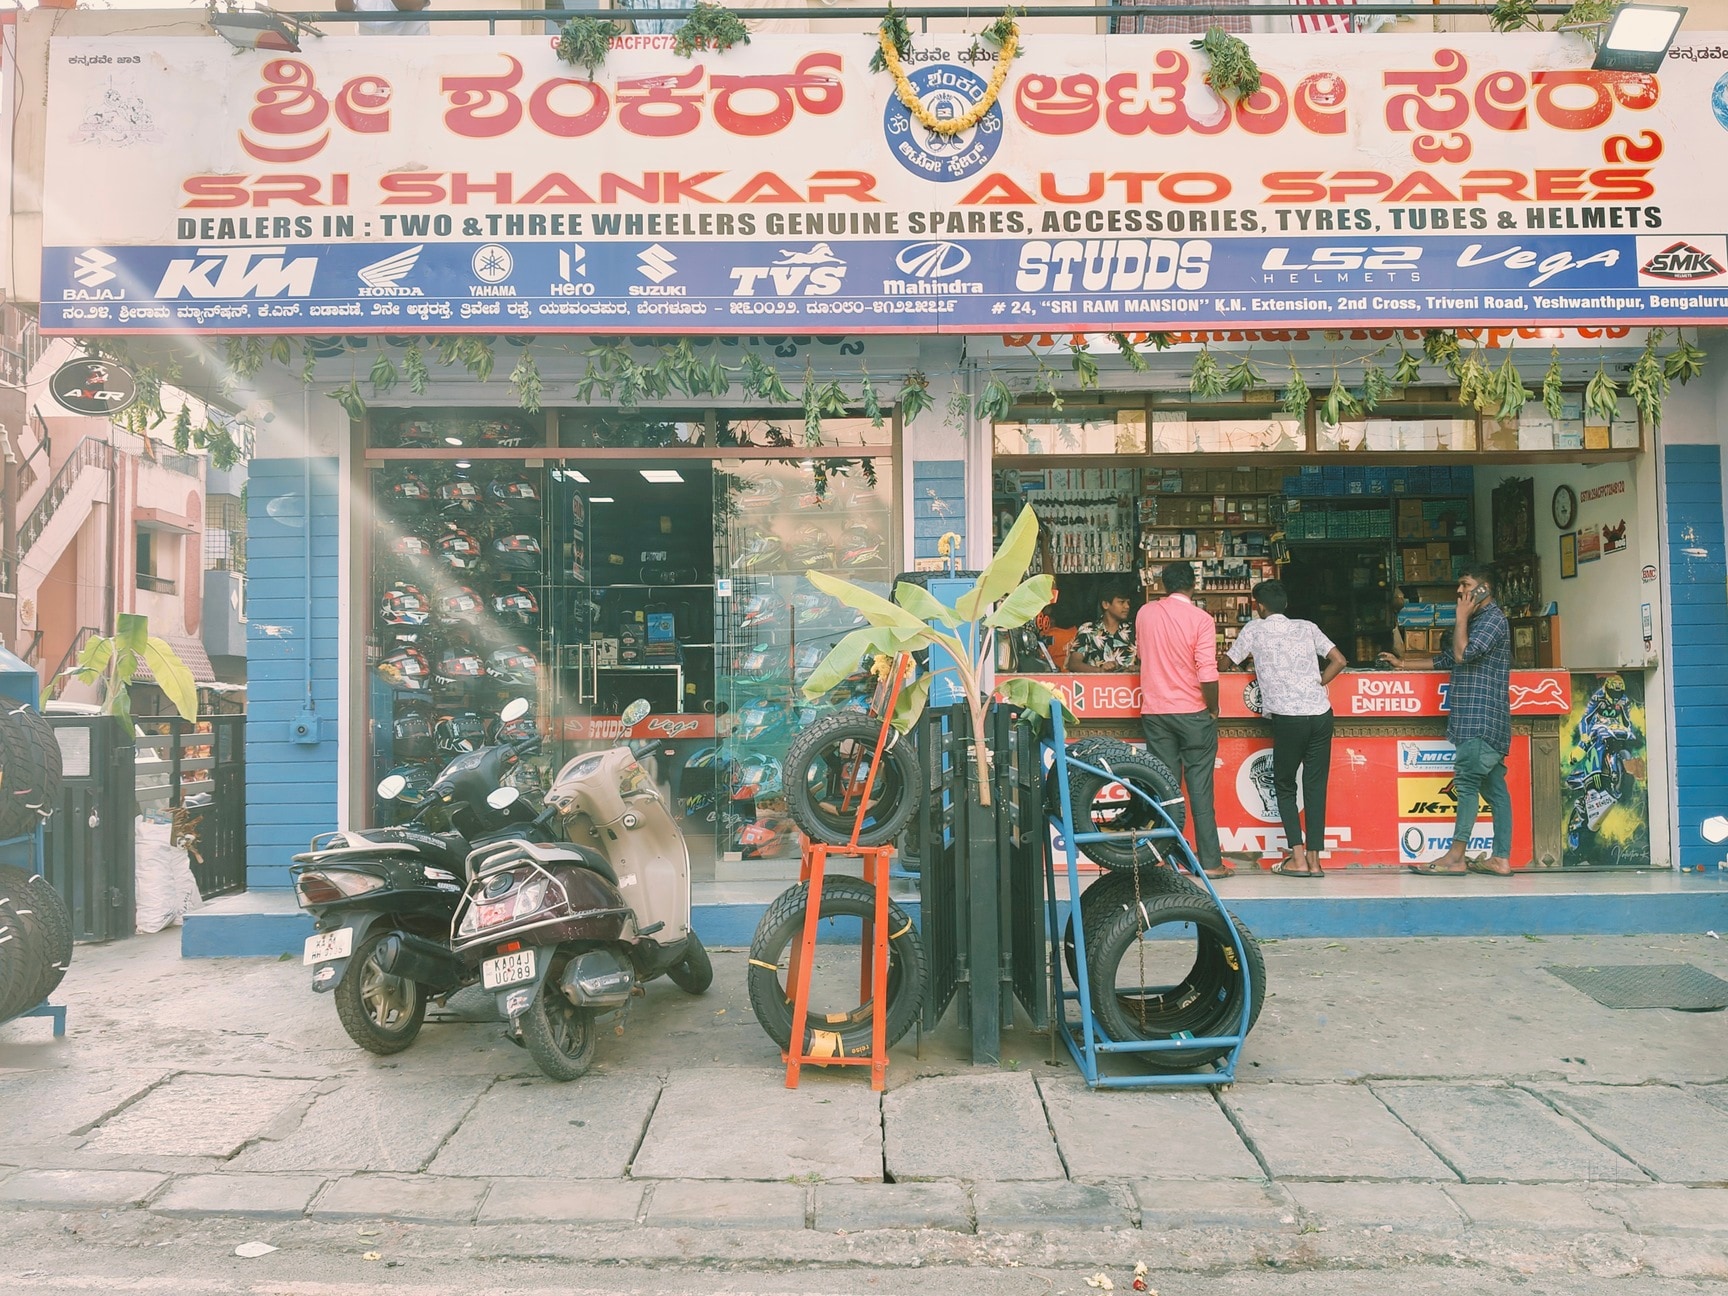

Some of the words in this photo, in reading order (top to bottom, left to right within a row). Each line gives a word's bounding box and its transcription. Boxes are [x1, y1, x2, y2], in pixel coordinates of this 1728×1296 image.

[68, 55, 113, 66] ಕನ್ನಡವೇ
[116, 55, 141, 64] ಜಾತಿ
[898, 47, 950, 65] ನ್ನಡವೇ
[239, 57, 393, 164] ಶ್ರೀ
[440, 52, 844, 139] ಶಂಕರ್
[180, 173, 351, 208] SRI
[377, 170, 884, 207] SHANKAR
[954, 169, 1232, 206] AUTO
[1260, 168, 1656, 204] SPARES
[178, 215, 312, 240] DEALERS
[323, 214, 354, 238] IN
[380, 213, 452, 238] TWO
[592, 212, 756, 236] WHEELERS
[766, 211, 899, 235] GENUINE
[908, 210, 1033, 236] SPARES,
[1041, 209, 1268, 235] ACCESSORIES,
[1275, 208, 1381, 233] TYRES,
[1389, 207, 1488, 231] TUBES
[1497, 208, 1517, 230] &
[1527, 206, 1664, 230] HELMETS
[1016, 240, 1212, 293] STUDDS
[1262, 247, 1423, 271] LS2
[1651, 254, 1713, 272] SMK
[154, 246, 319, 299] KTM
[729, 266, 848, 296] TVS
[1263, 273, 1421, 284] HELMETS
[63, 289, 125, 301] BAJAJ
[358, 287, 424, 297] HONDA
[469, 286, 516, 296] YAHAMA
[628, 285, 686, 297] SUZUKI
[883, 279, 983, 295] Mahindra
[118, 304, 171, 323] ಶ್ರೀರಾಮ
[992, 301, 1006, 314] #
[1011, 301, 1036, 316] 24,
[1083, 300, 1119, 313] RAM
[1215, 299, 1246, 312] K.N.
[1252, 298, 1333, 313] Extension,
[1337, 297, 1367, 310] 2nd
[1372, 297, 1422, 311] Cross,
[1426, 296, 1479, 310] Triveni
[1484, 296, 1528, 311] Road,
[1533, 295, 1645, 313] Yeshwanthpur,
[1650, 294, 1728, 311] Bengaluru
[63, 389, 125, 402] AXOR
[1358, 678, 1414, 696] ROYAL
[1351, 695, 1421, 714] ENFIELD
[1260, 809, 1280, 817] MR
[494, 952, 530, 972] KA04J
